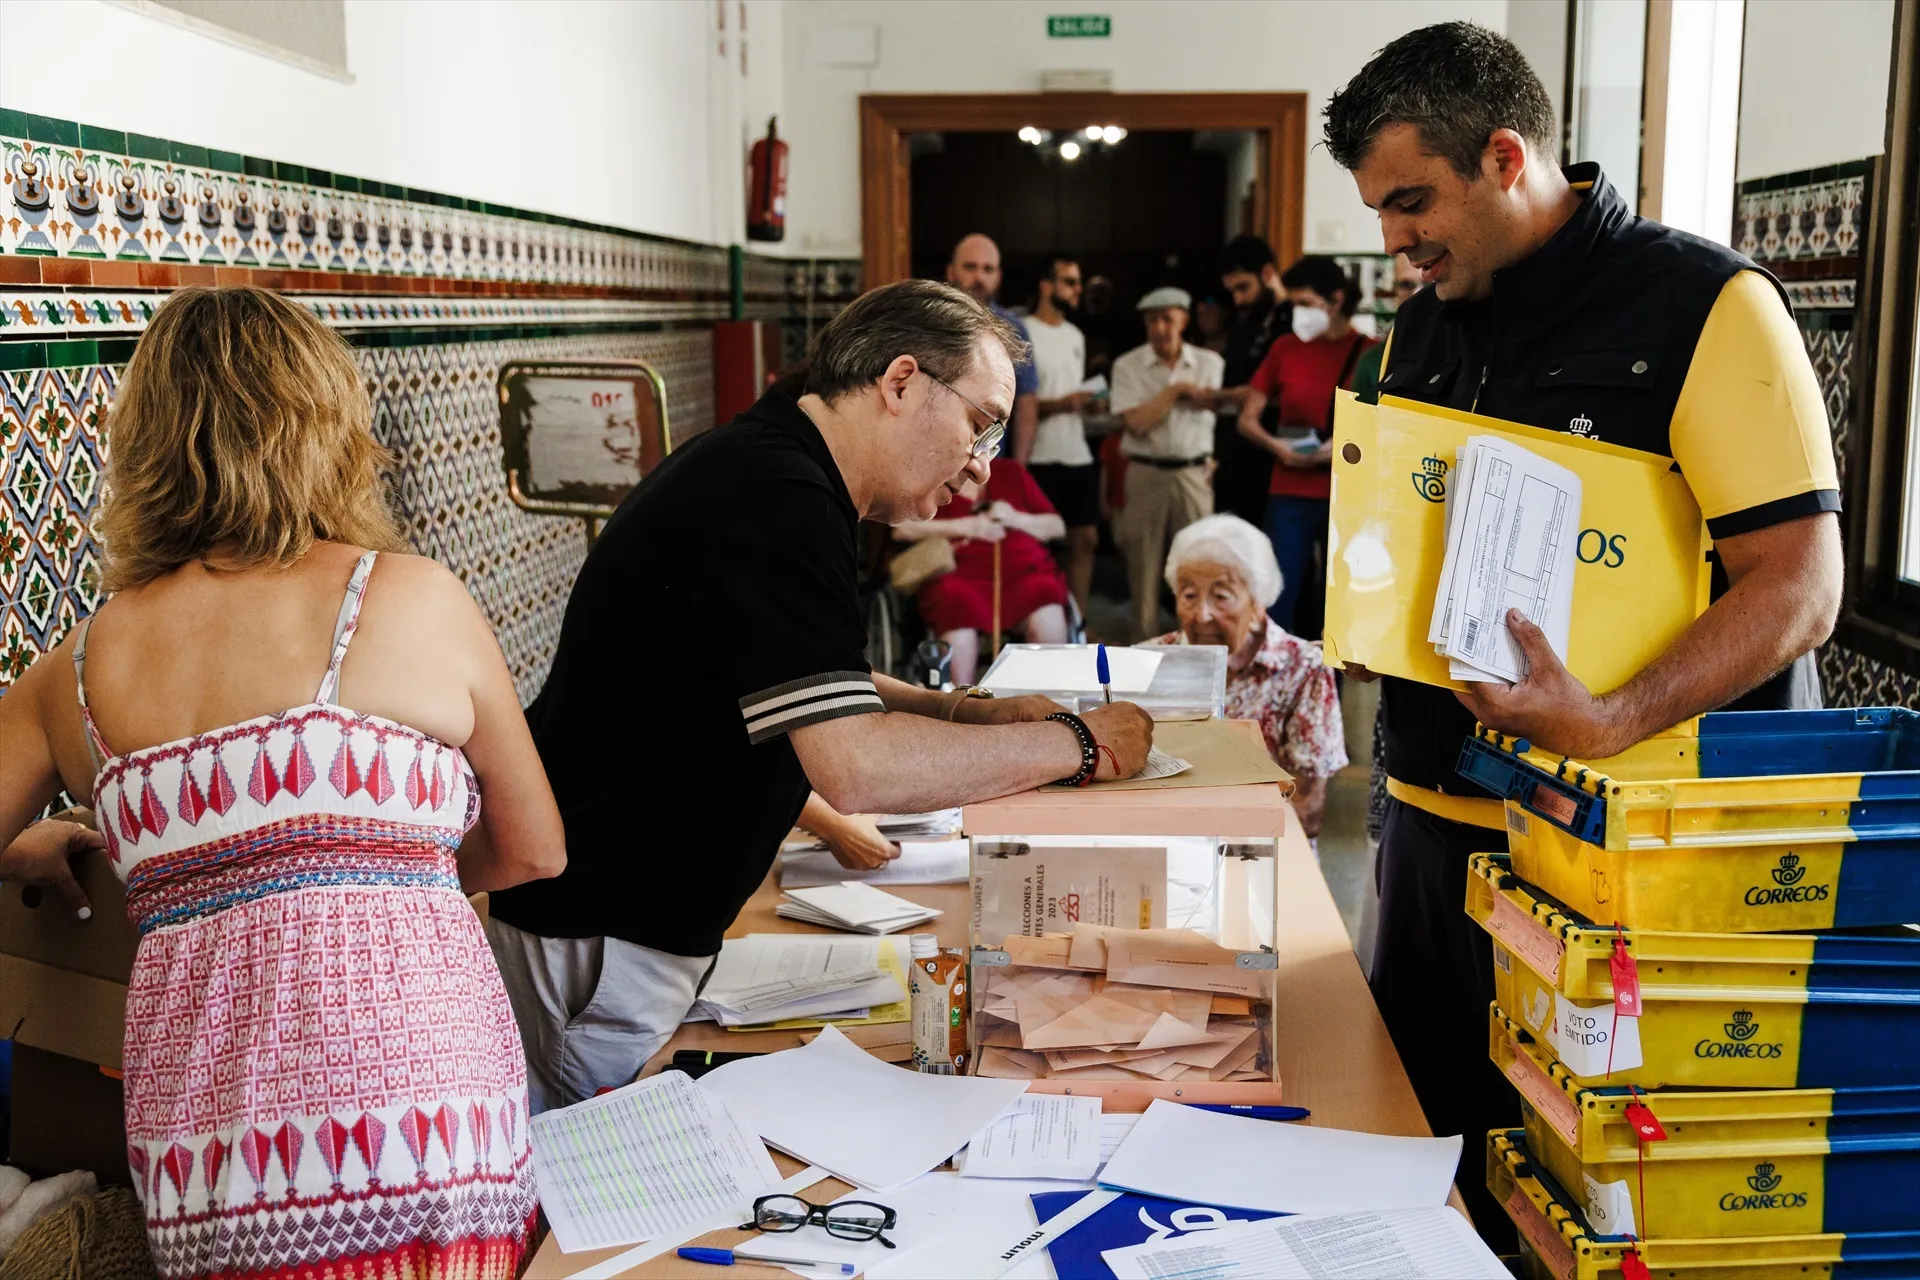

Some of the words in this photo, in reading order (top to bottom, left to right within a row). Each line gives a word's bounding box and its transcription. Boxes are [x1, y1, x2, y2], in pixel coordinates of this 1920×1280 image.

[1035, 864, 1045, 916] GENERALES
[1744, 884, 1829, 906] CORREOS
[1022, 885, 1032, 937] ELECCIONES
[1048, 897, 1057, 919] 2023
[1035, 917, 1044, 938] RTES
[1567, 1010, 1596, 1029] VOTO
[1565, 1024, 1608, 1046] EMITIDO
[1694, 1039, 1783, 1059] CORREOS
[1719, 1192, 1808, 1212] CORREOS
